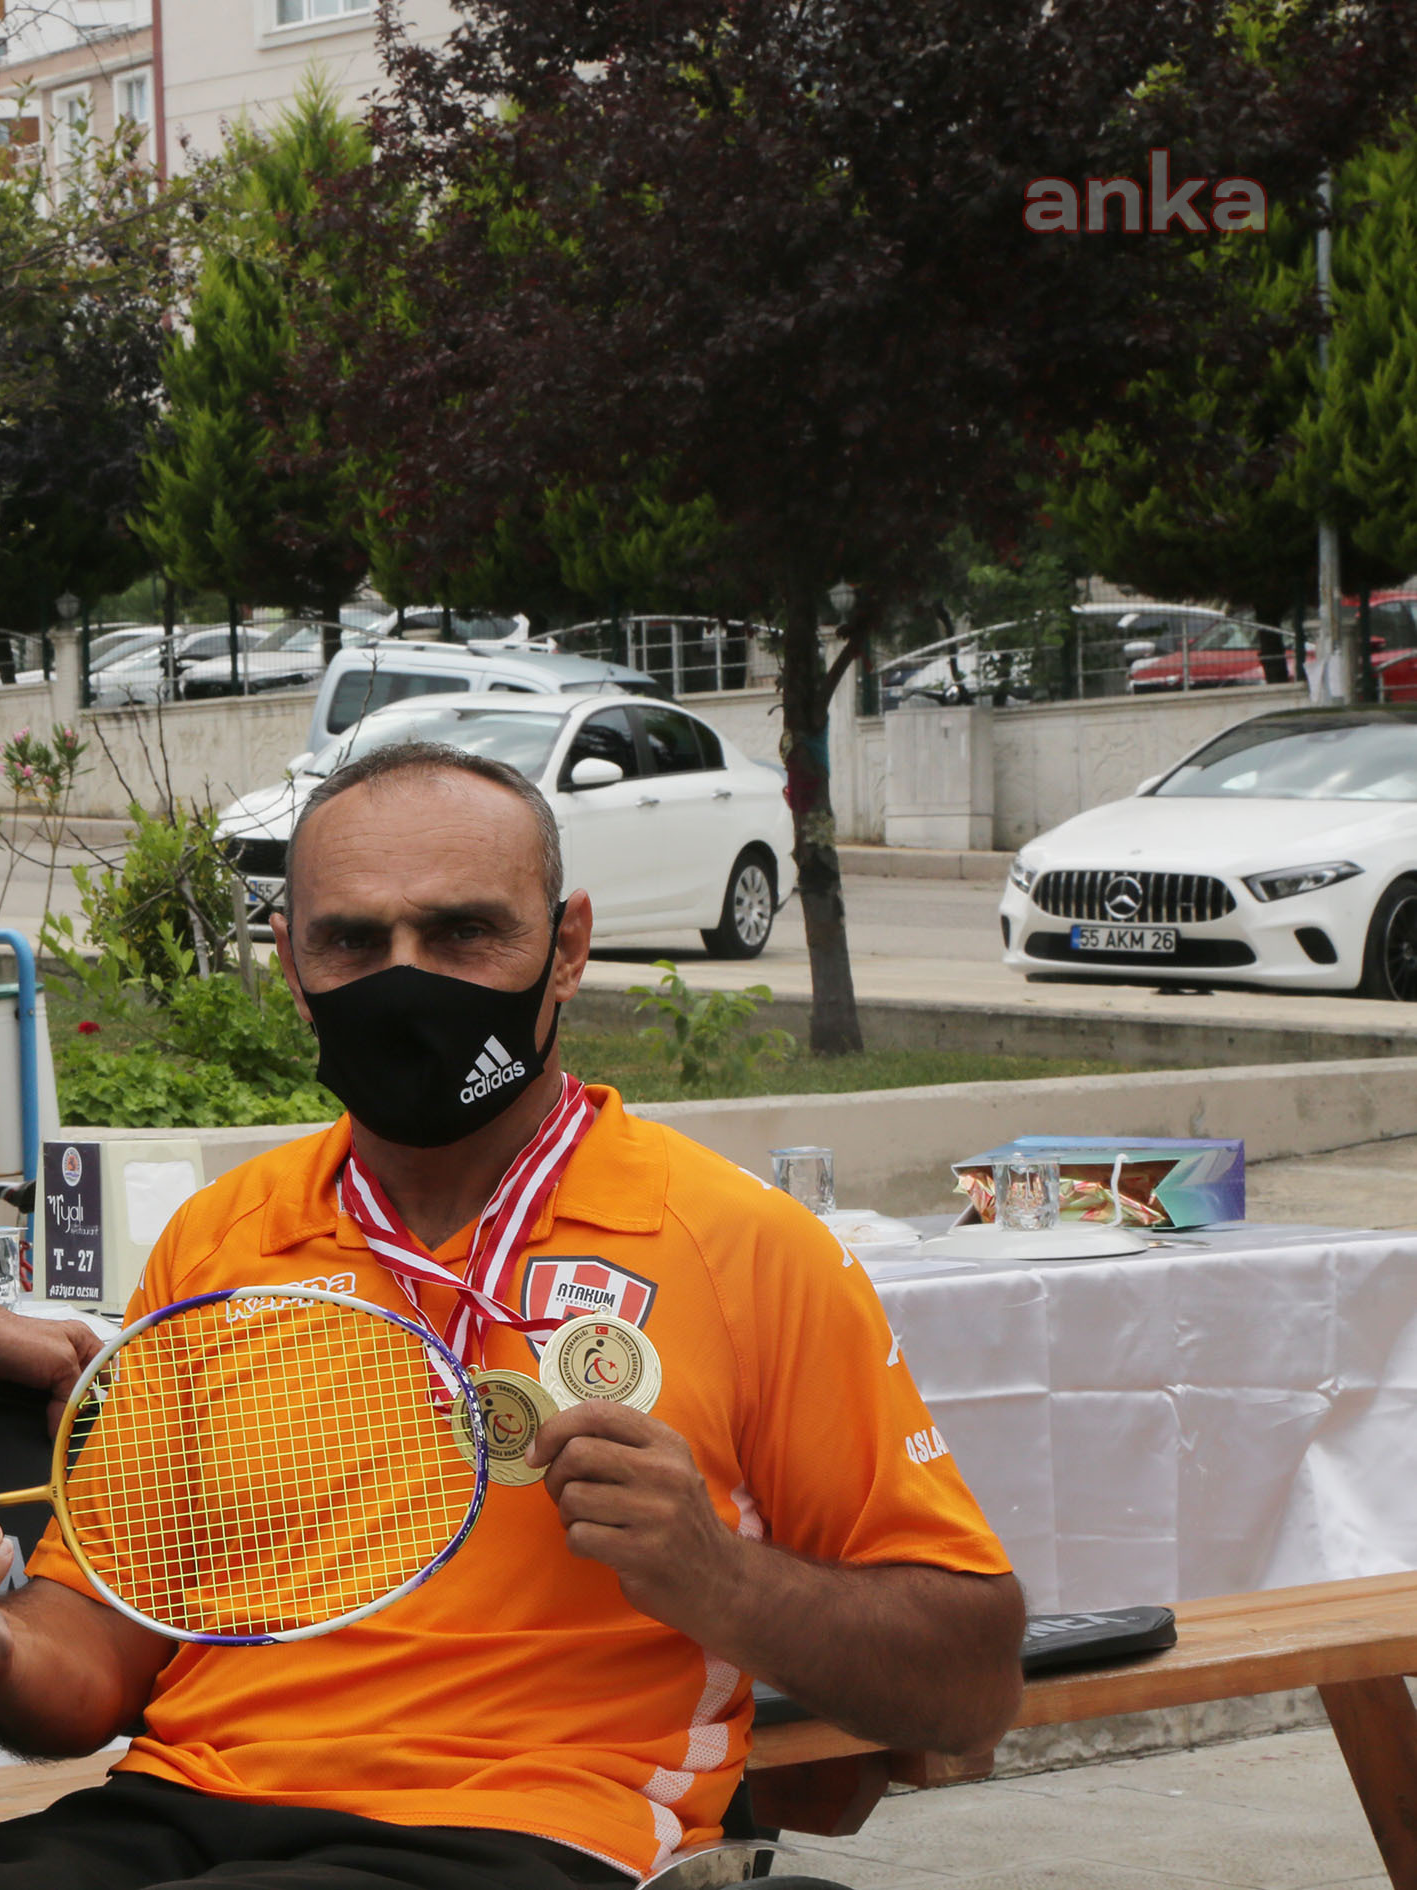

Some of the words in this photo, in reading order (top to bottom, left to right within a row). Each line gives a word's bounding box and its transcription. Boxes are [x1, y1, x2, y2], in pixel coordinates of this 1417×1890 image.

[1080, 929, 1099, 948] 55
[1105, 930, 1145, 949] AKM
[1151, 932, 1174, 950] 26
[459, 1060, 526, 1104] adidas
[53, 1248, 64, 1271] T
[78, 1249, 94, 1272] 27
[557, 1282, 616, 1308] ATAKUM
